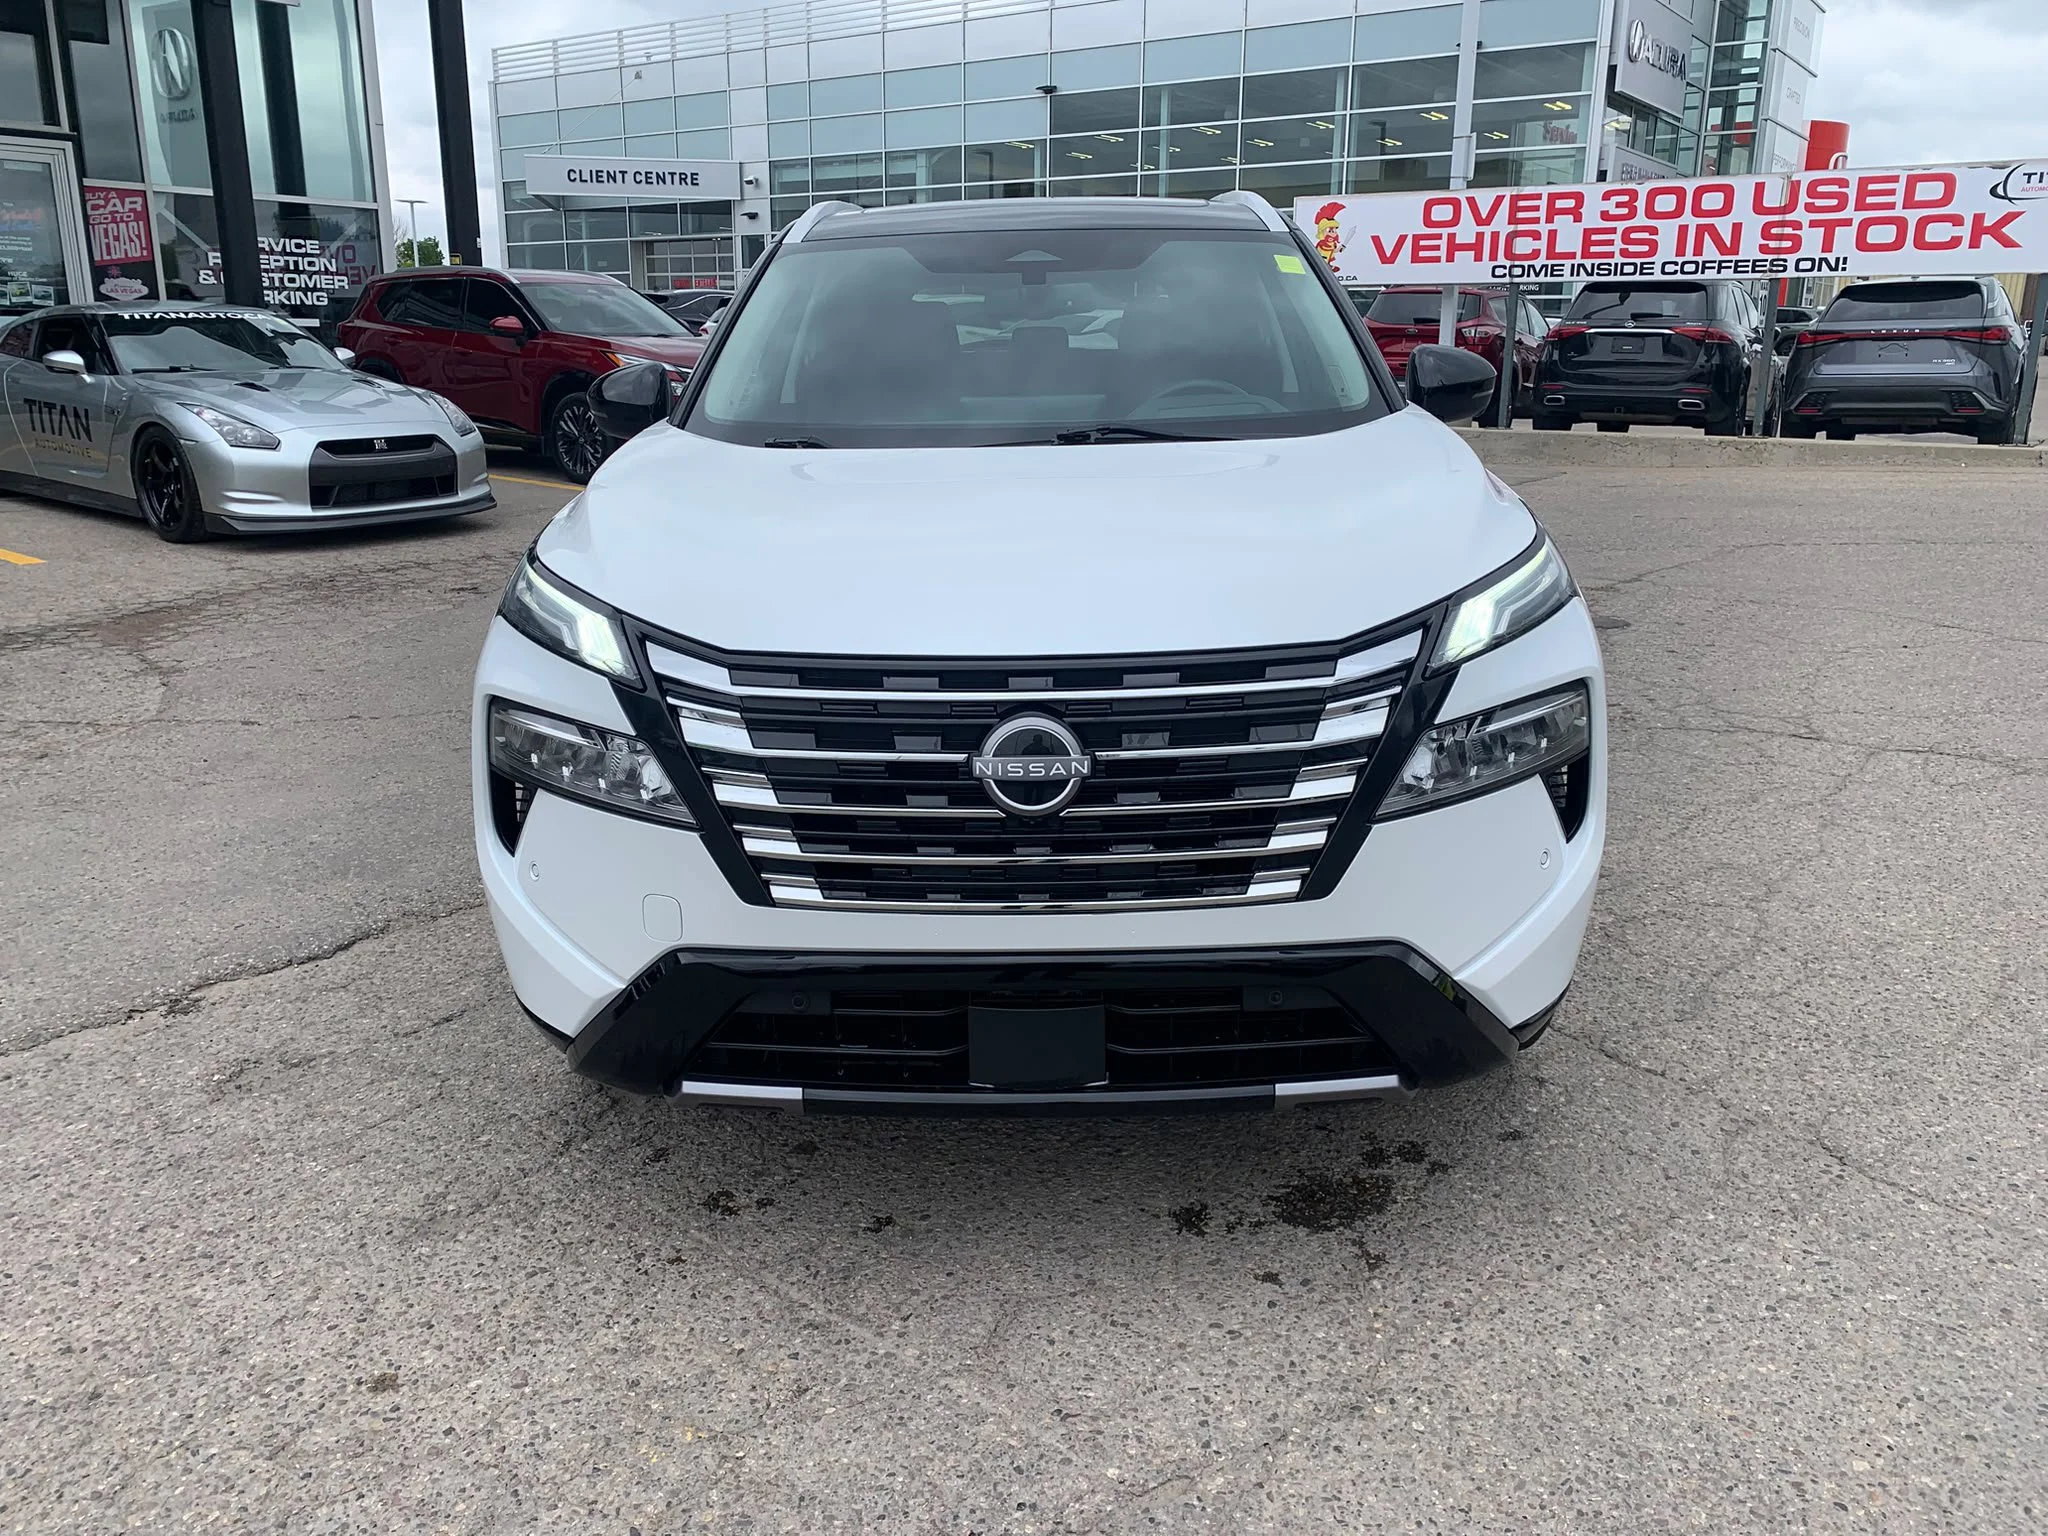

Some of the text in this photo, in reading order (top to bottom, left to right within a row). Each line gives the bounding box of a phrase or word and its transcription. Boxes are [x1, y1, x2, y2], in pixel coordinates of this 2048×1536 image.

[1642, 34, 1687, 81] ACURA
[567, 168, 700, 186] CLIENT CENTRE
[2022, 172, 2048, 184] TI
[108, 191, 117, 199] A
[1422, 172, 1957, 229] OVER 300 USED
[86, 197, 143, 215] CAR
[89, 212, 135, 224] GO TO
[89, 221, 148, 261] VEGAS!
[257, 236, 321, 255] RVICE
[1371, 211, 2023, 265] VEHICLES IN STOCK
[1490, 256, 1848, 279] COME INSIDE COFFEES ON!
[198, 269, 217, 285] &
[263, 290, 329, 306] RKING
[117, 311, 272, 321] TITANAUTO.CA
[23, 398, 93, 443] TITAN
[975, 760, 1088, 777] NISSAN
